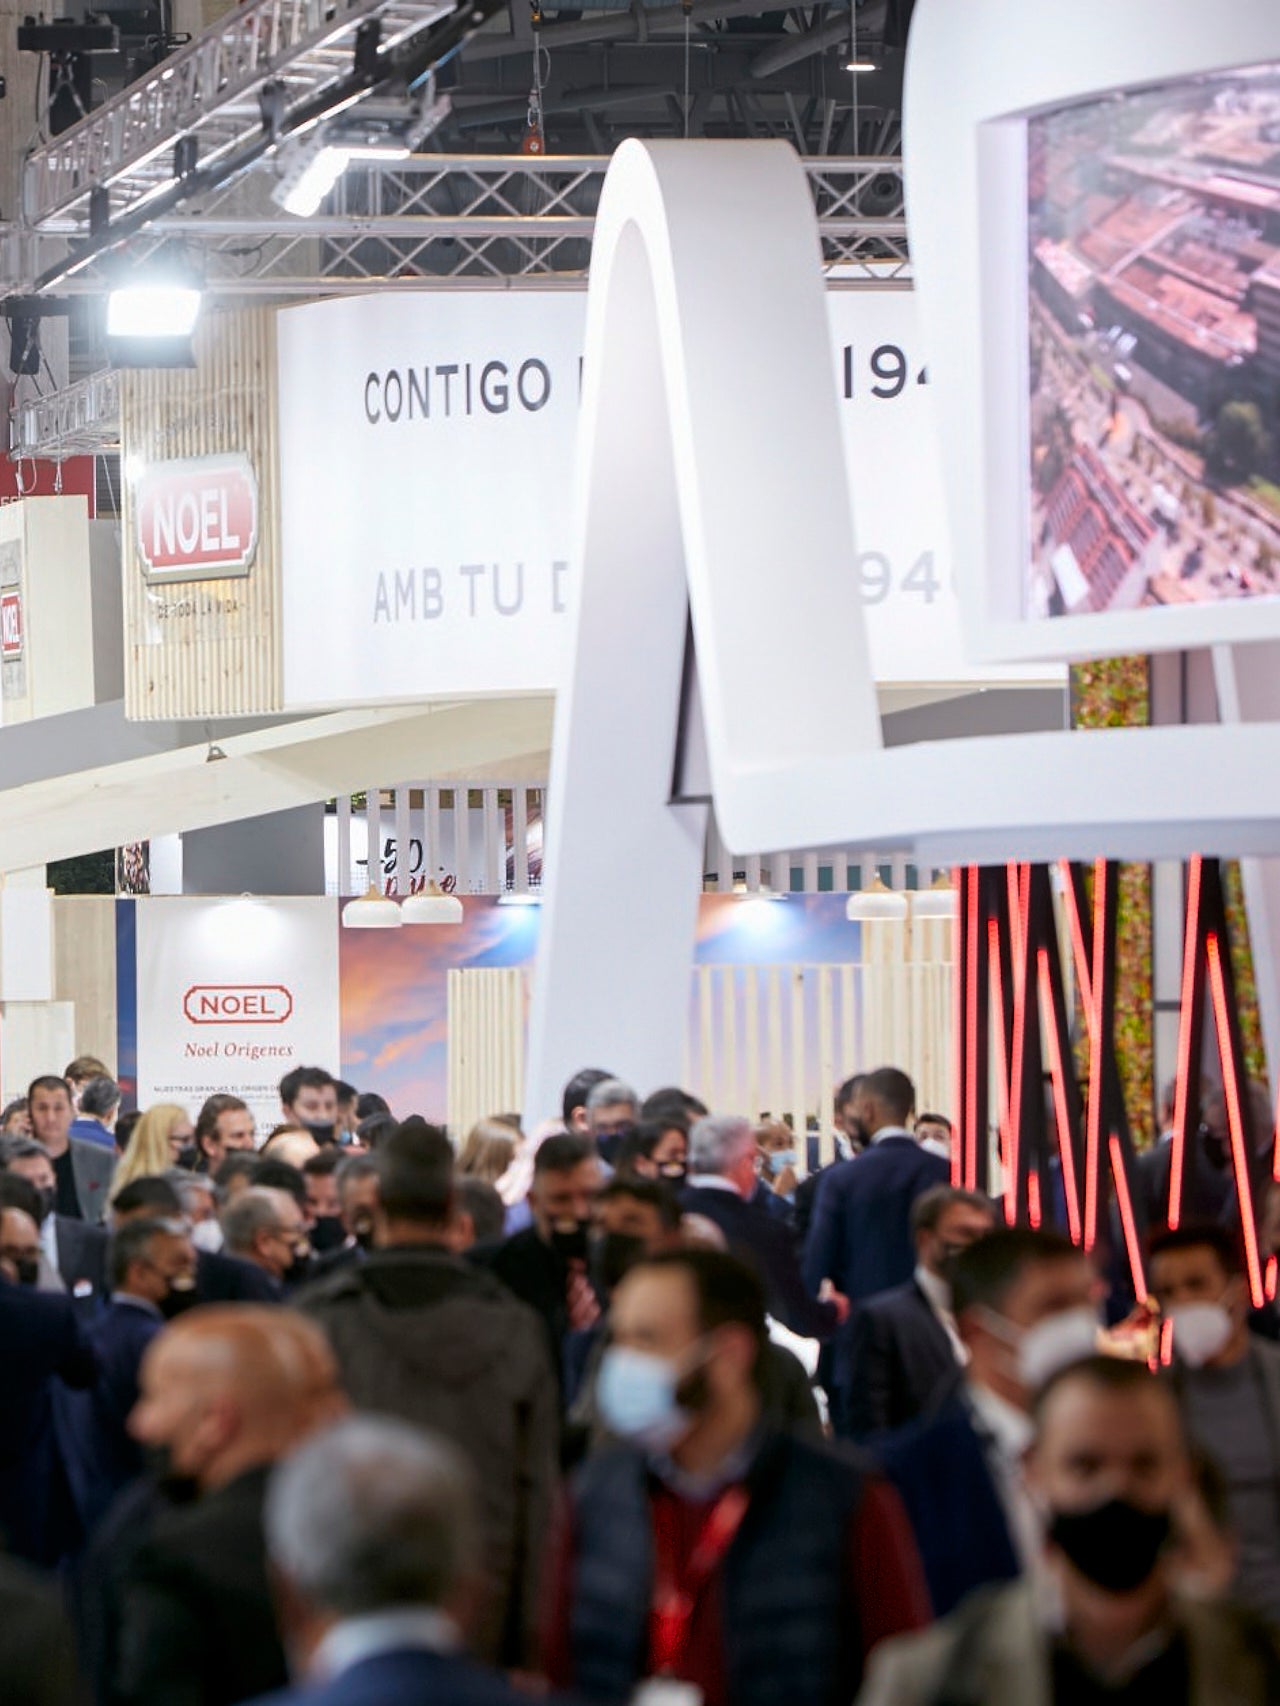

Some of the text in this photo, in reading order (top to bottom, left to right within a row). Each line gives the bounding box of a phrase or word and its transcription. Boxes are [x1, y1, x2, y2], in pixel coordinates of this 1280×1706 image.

[365, 357, 552, 424] CONTIGO
[843, 344, 929, 399] 19
[153, 487, 241, 557] NOEL
[373, 566, 444, 624] AMB
[460, 563, 524, 617] TU
[201, 995, 276, 1014] NOEL
[184, 1042, 293, 1060] Noel Origenes
